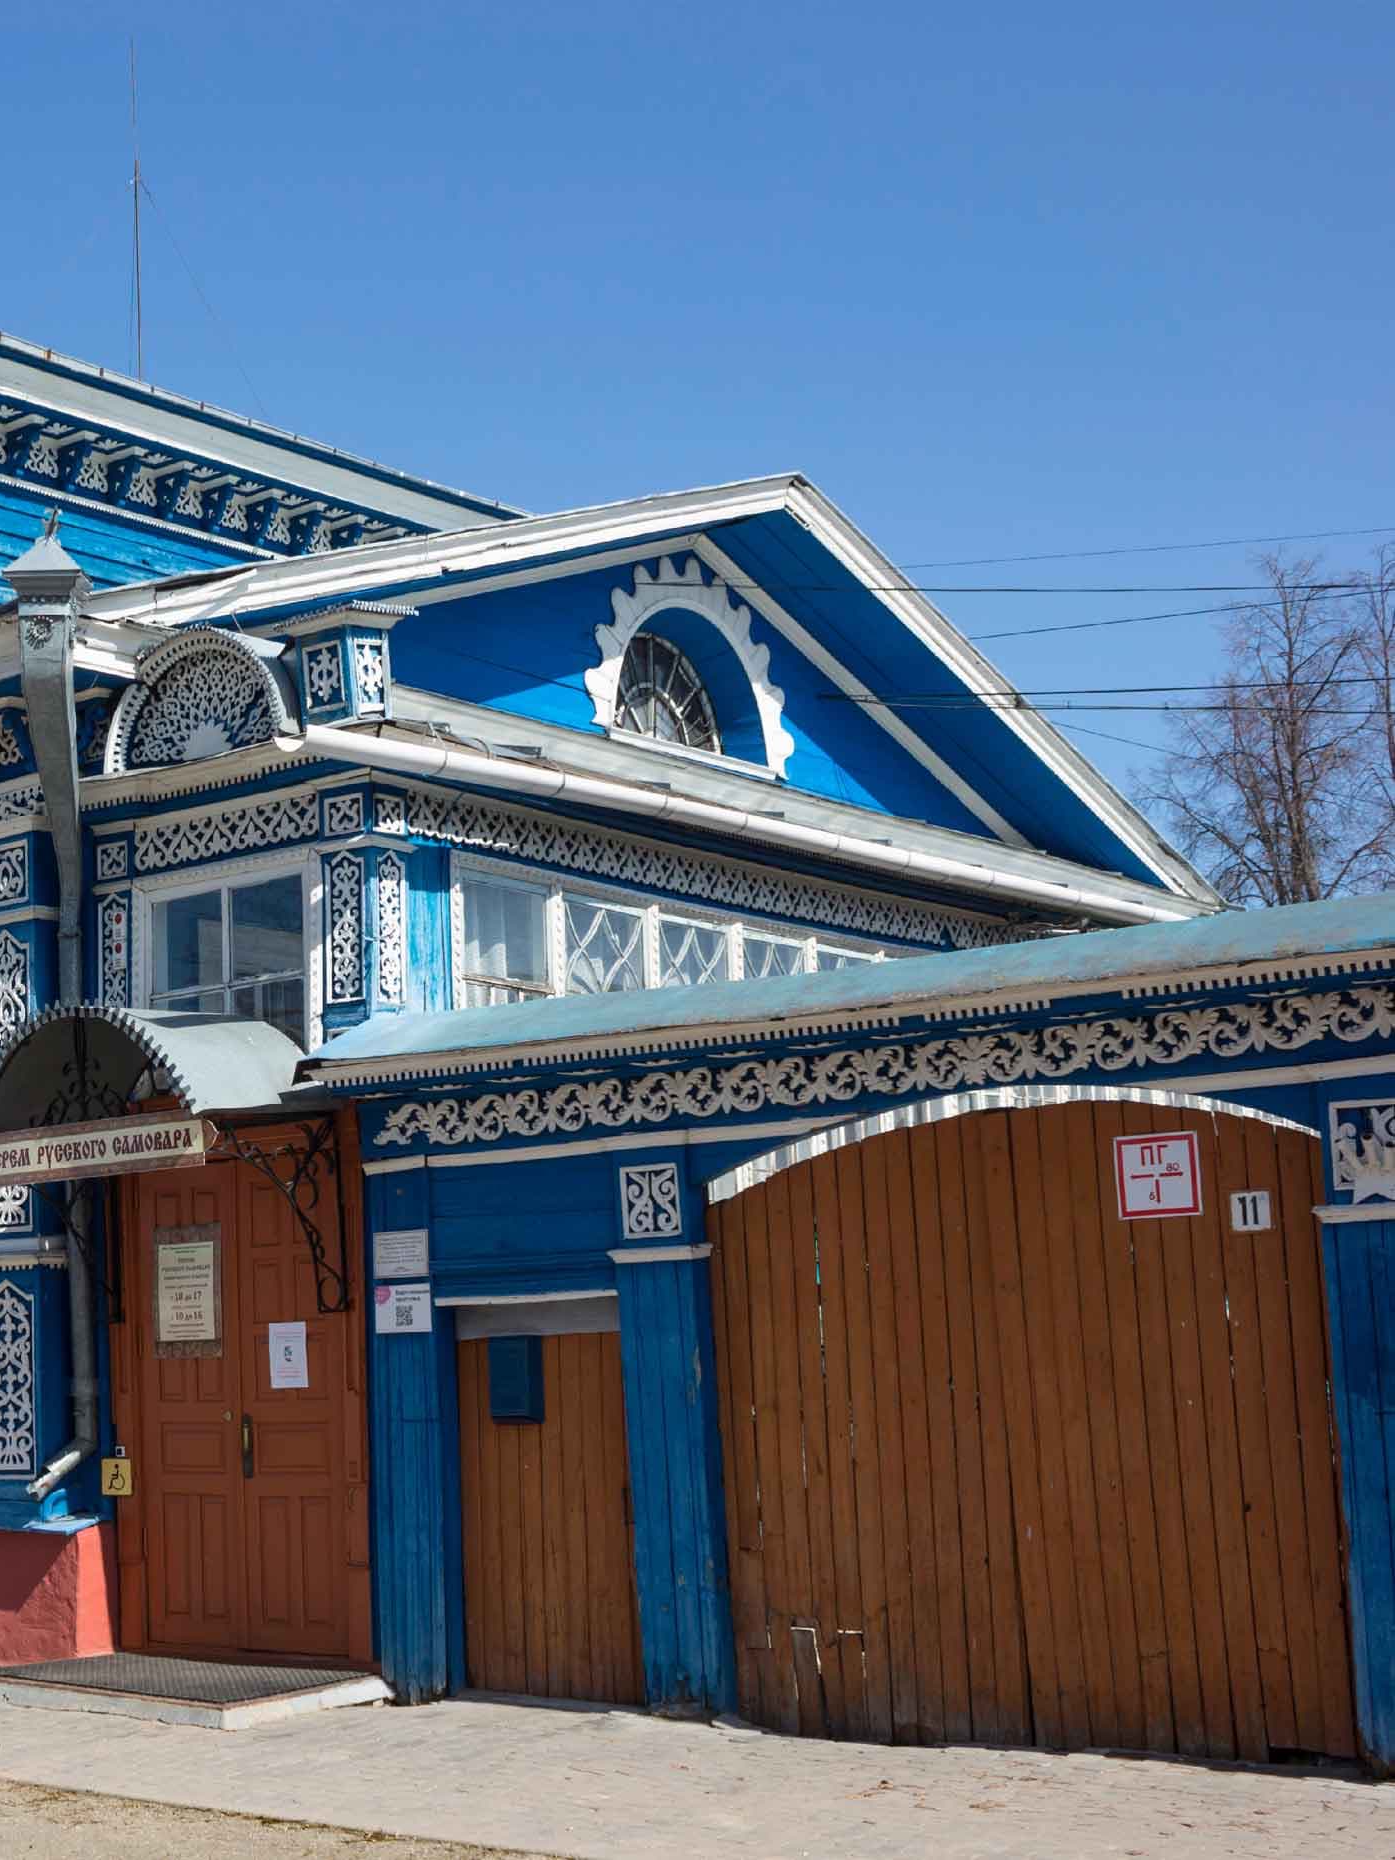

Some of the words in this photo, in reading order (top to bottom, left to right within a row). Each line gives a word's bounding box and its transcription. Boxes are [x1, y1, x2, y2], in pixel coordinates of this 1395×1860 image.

[37, 1138, 106, 1168] РУССКОГО
[112, 1127, 193, 1156] САМОВАРА
[1140, 1144, 1168, 1166] ПГ
[1165, 1162, 1180, 1171] 80
[1237, 1195, 1260, 1226] 11
